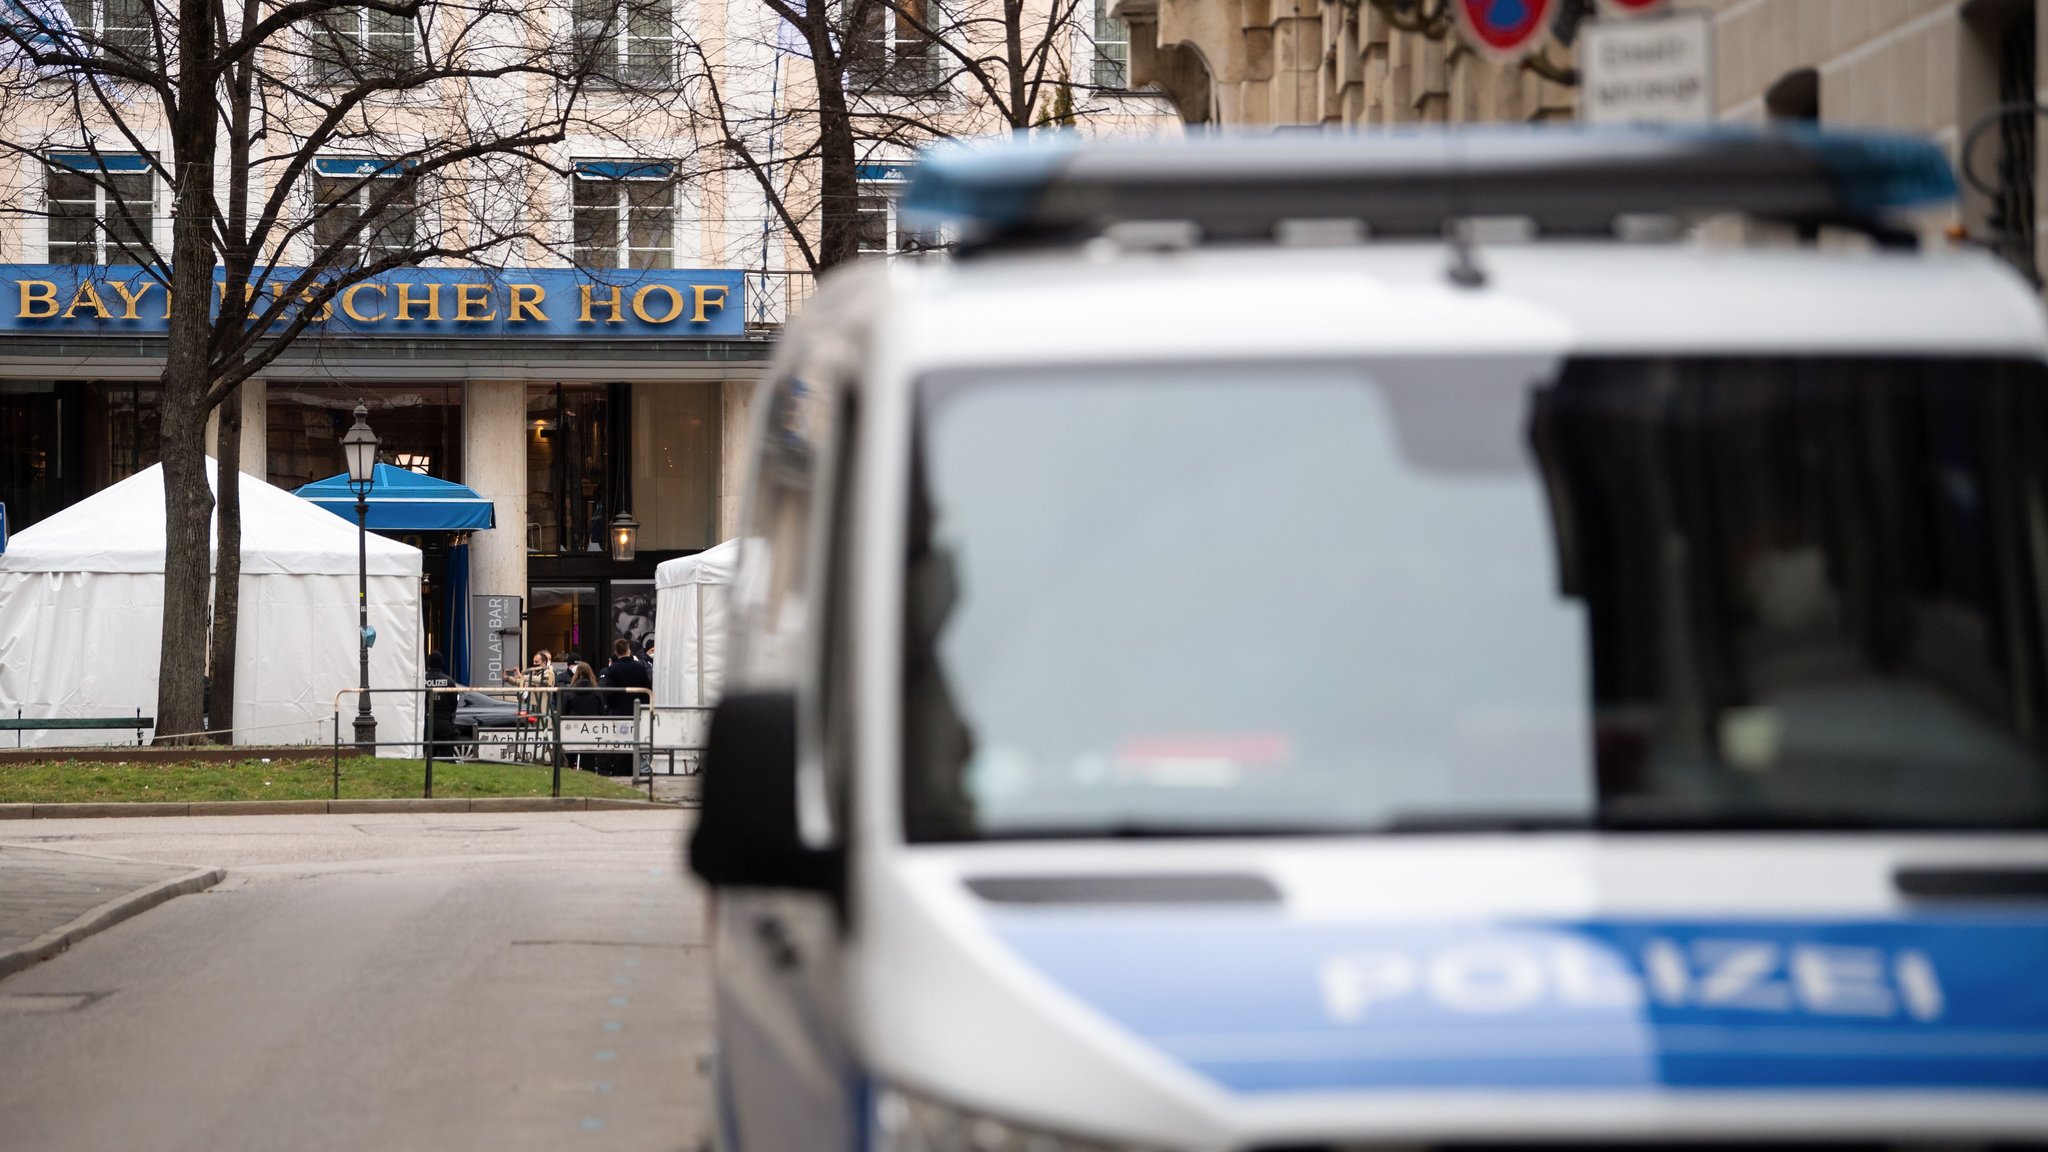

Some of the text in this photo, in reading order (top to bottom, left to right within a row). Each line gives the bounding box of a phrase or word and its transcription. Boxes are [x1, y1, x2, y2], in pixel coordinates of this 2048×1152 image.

[14, 278, 730, 324] BAYISCHER HOF
[489, 598, 502, 628] BAR
[492, 734, 543, 748] Achng
[1321, 939, 1944, 1023] POLIZEI
